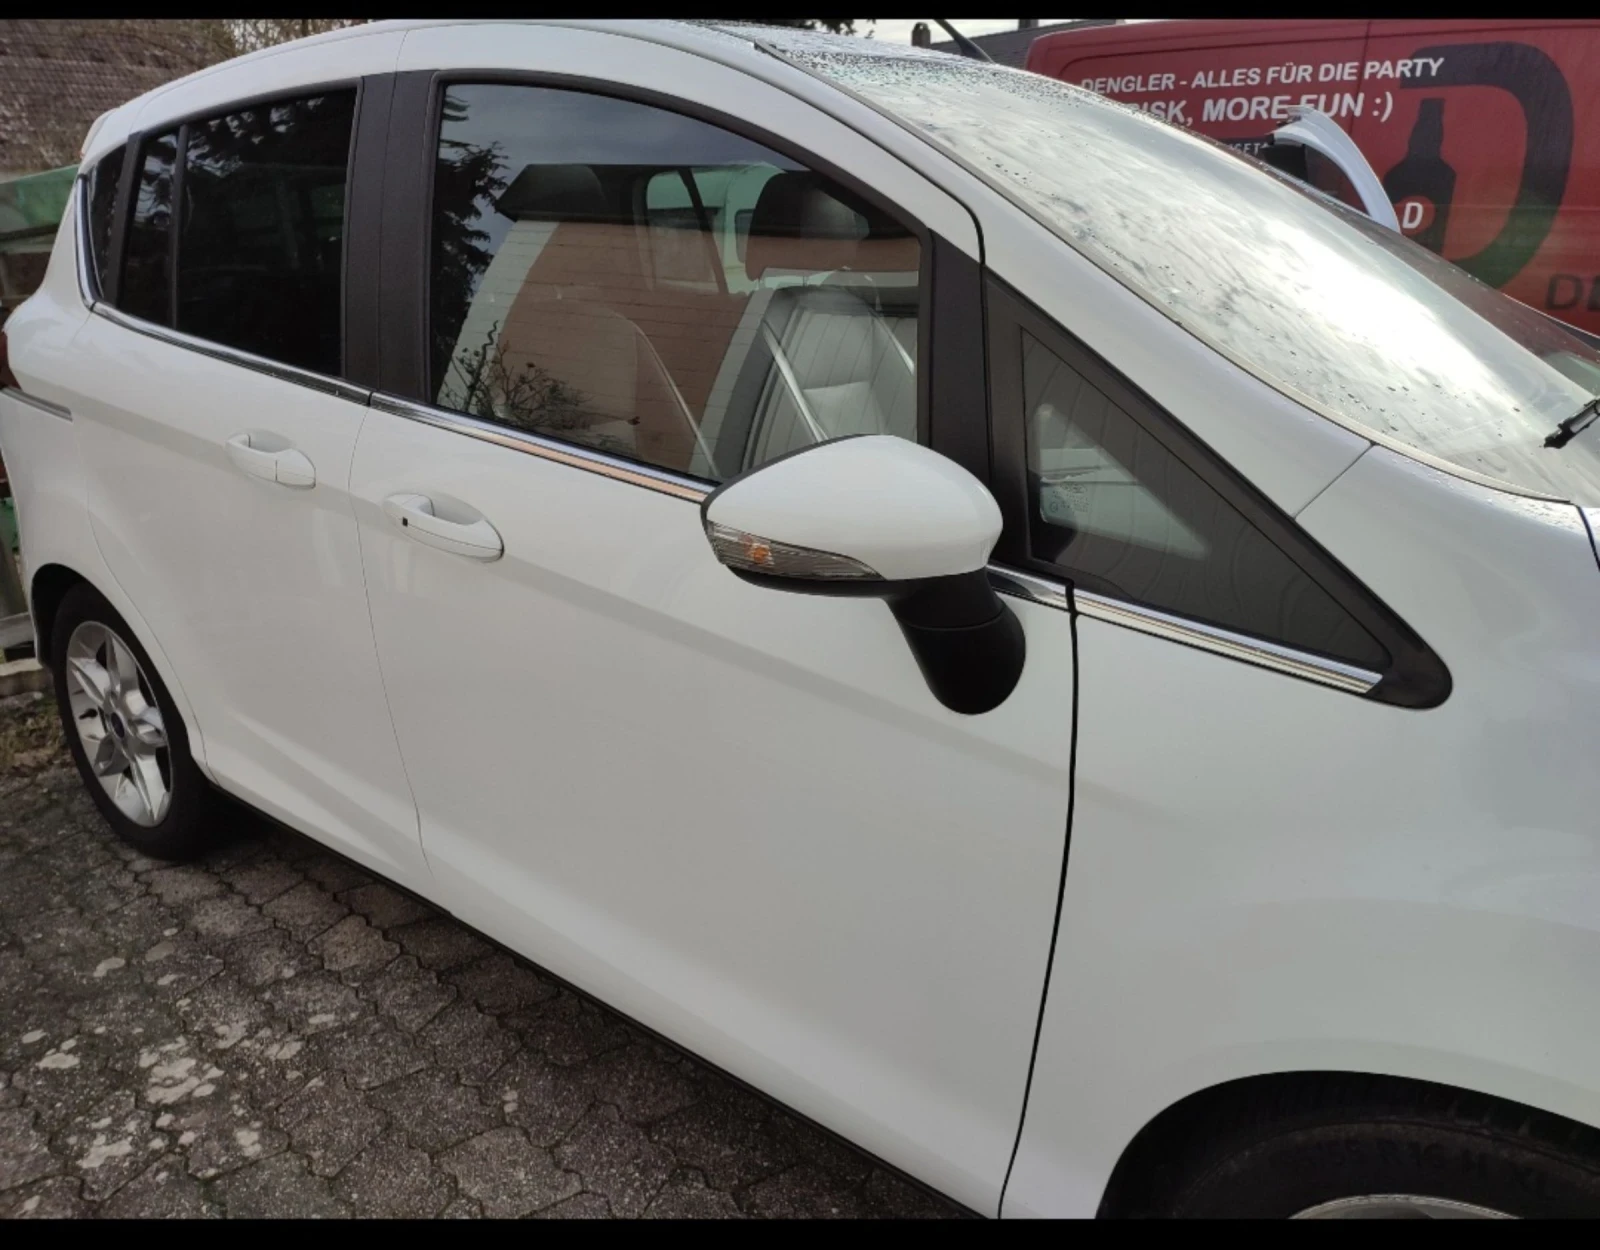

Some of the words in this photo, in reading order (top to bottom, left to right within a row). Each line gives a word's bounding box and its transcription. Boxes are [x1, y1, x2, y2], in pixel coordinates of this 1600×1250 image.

[1080, 73, 1176, 95] DENGLER
[1191, 67, 1262, 89] ALLES
[1266, 61, 1313, 85] FÜR
[1318, 61, 1360, 83] DIE
[1364, 57, 1445, 80] PARTY
[1202, 94, 1292, 122] MORE
[1402, 202, 1424, 229] D
